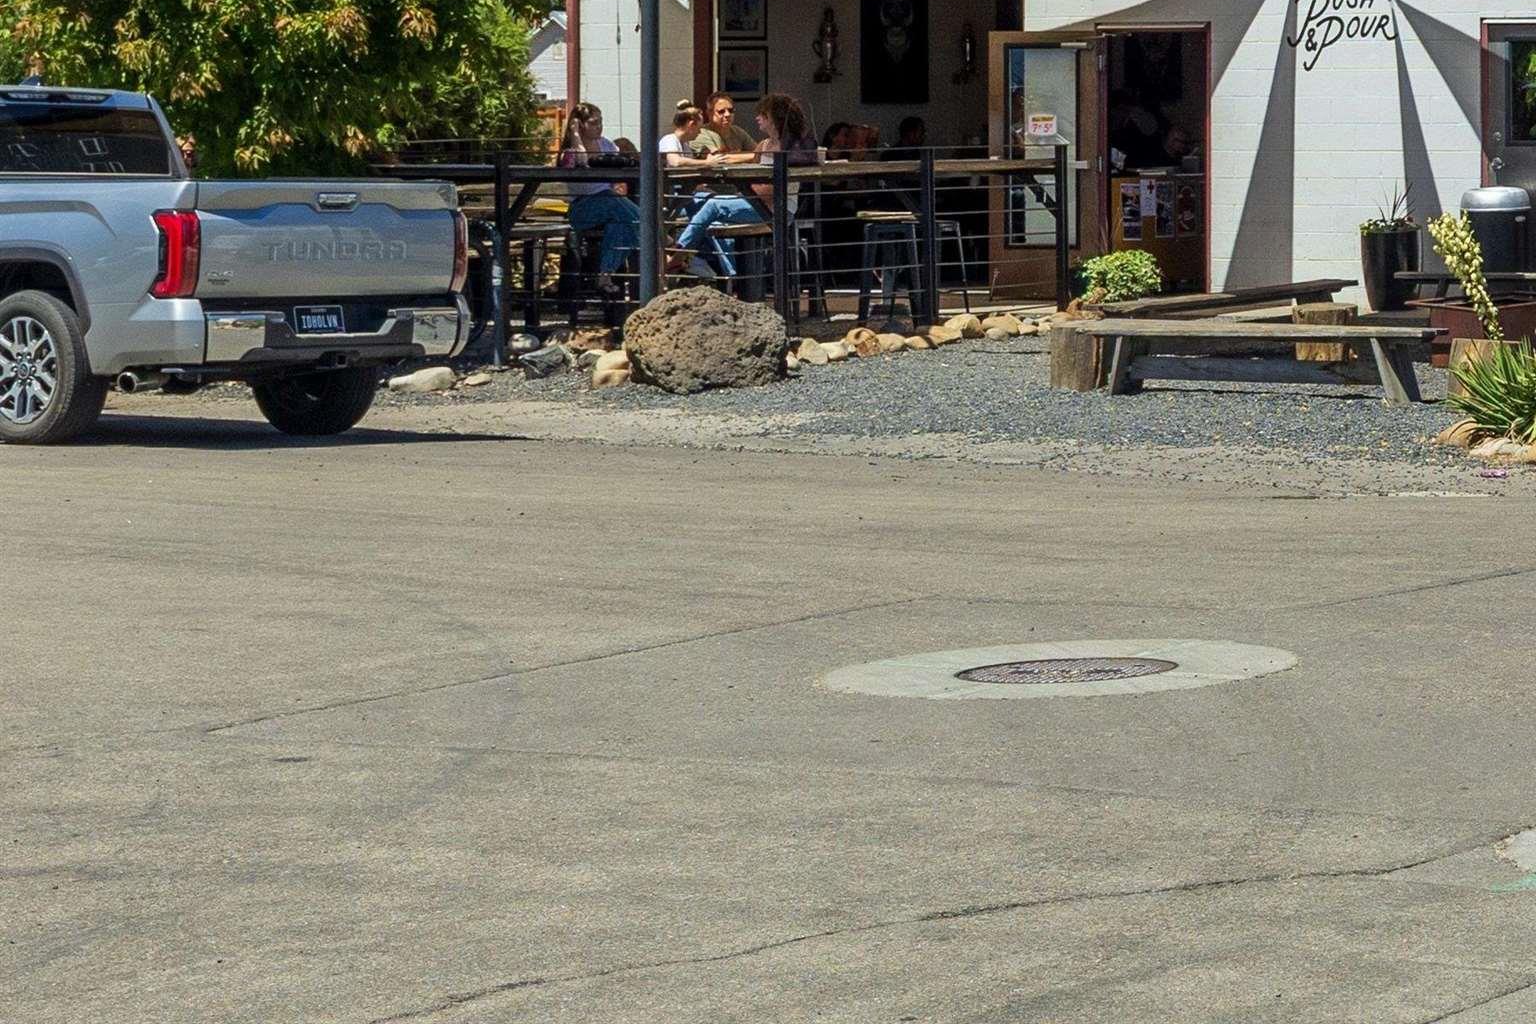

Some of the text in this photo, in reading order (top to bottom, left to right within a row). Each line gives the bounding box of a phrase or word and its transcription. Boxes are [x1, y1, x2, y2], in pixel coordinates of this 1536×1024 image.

[1303, 14, 1398, 71] & POUR
[264, 238, 408, 263] TUNDRA
